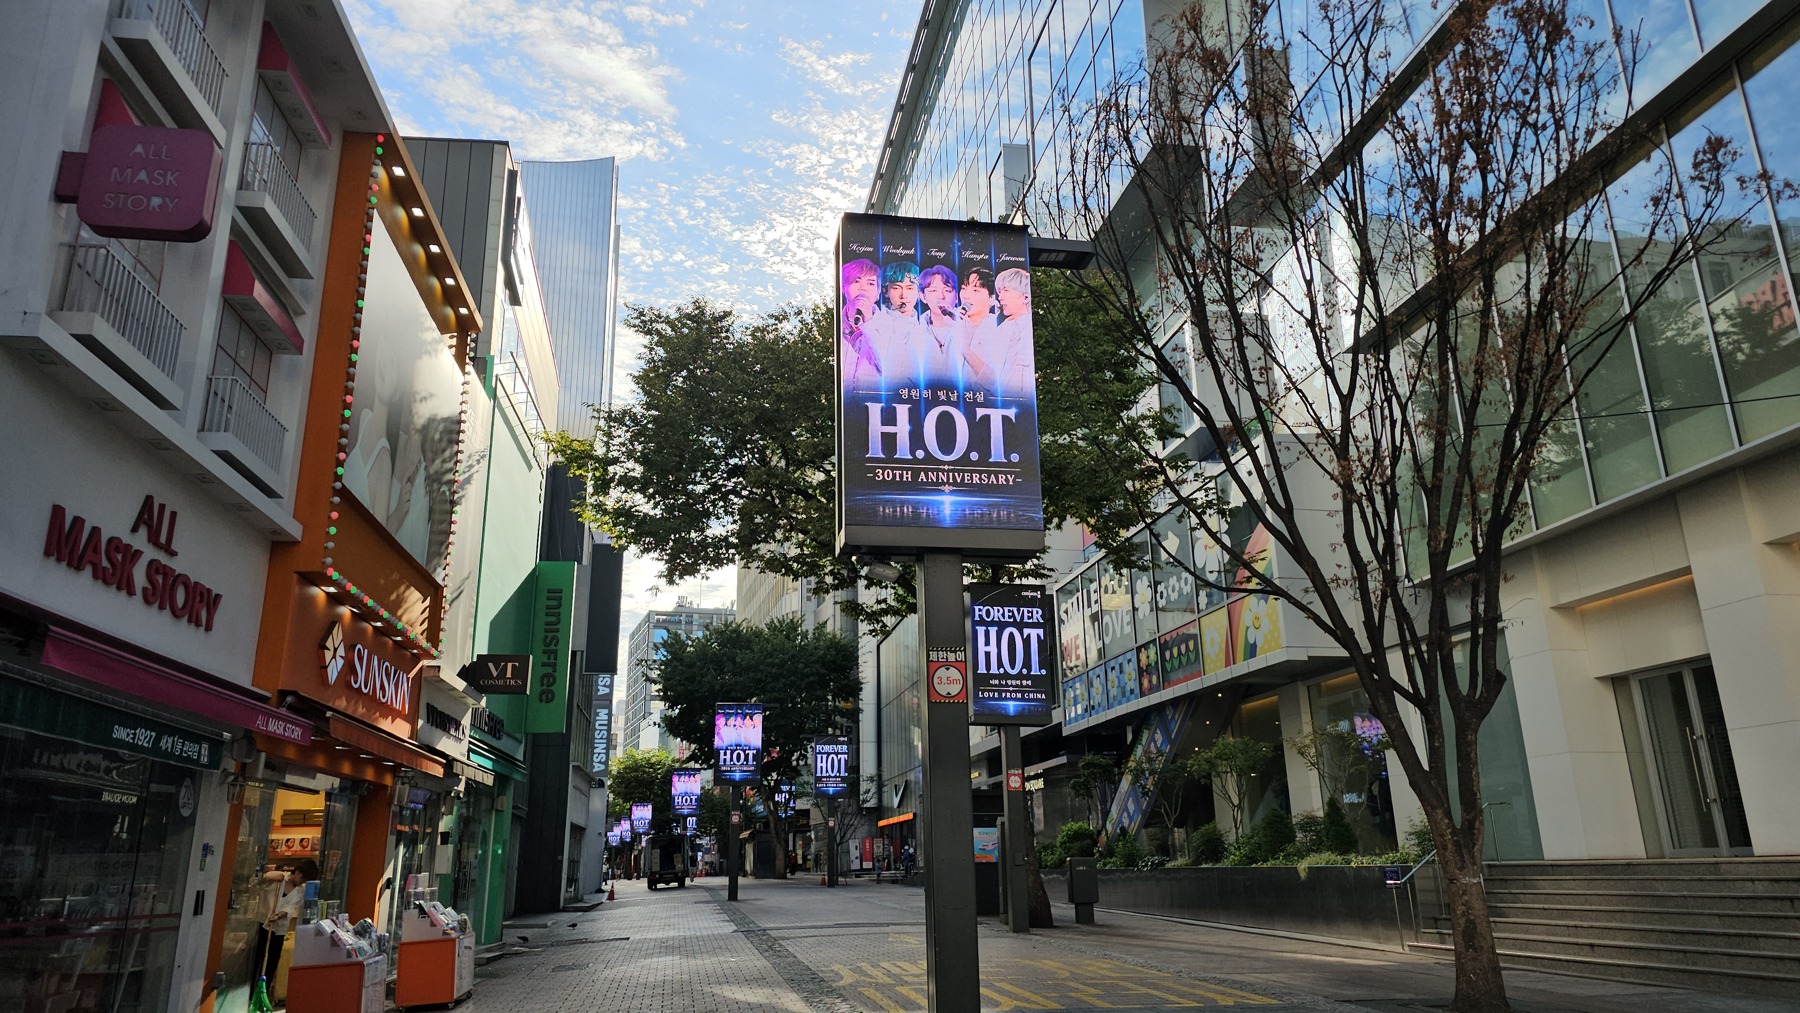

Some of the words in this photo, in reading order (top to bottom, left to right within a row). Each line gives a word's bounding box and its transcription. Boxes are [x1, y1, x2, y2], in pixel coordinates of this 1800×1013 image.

[129, 143, 172, 160] ALL
[110, 167, 180, 187] MASK
[102, 193, 181, 213] STORY
[927, 248, 946, 259] Tony
[937, 390, 959, 402] 빛날
[964, 391, 985, 402] 전설
[865, 402, 1020, 462] H.O.T.
[130, 494, 178, 556] ALL
[43, 503, 144, 596] MASK
[142, 558, 223, 631] STORY
[973, 605, 1044, 622] FOREVER
[1094, 604, 1132, 650] LOVE
[975, 626, 1047, 675] H.O.T.
[351, 643, 412, 714] SUNSKIN
[487, 662, 519, 678] VT
[936, 676, 962, 686] 3.5m
[256, 714, 268, 730] ALL
[267, 719, 285, 734] MASK
[285, 723, 303, 740] STORY
[592, 708, 609, 773] MUSINSA
[816, 744, 848, 753] FOREVER
[719, 749, 757, 765] H.O.T.
[816, 753, 849, 777] H.O.T.
